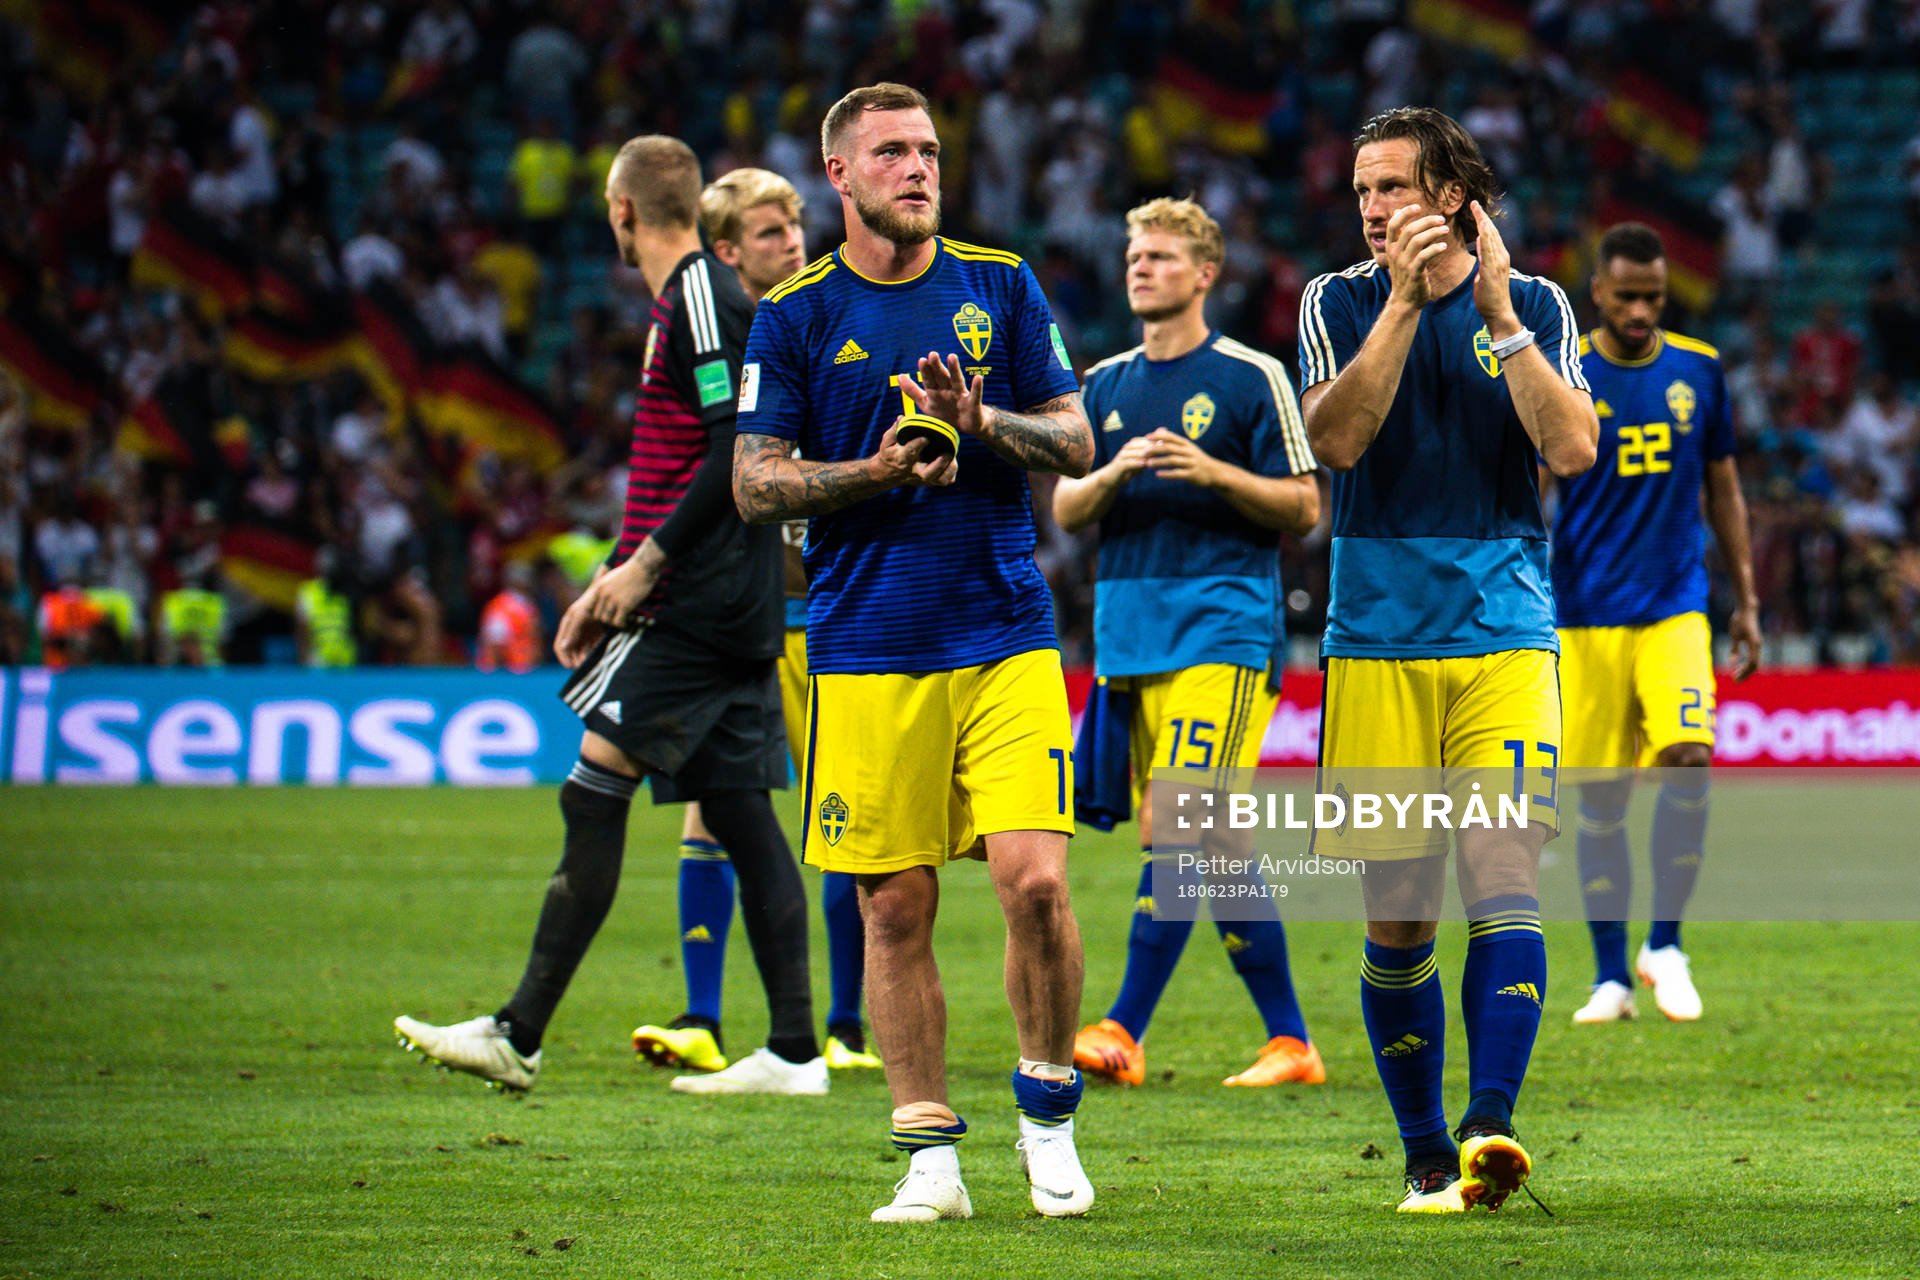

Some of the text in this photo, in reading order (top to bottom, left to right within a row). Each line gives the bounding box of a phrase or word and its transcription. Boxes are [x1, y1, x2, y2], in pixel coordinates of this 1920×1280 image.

[834, 351, 869, 365] adidas
[1617, 422, 1672, 477] 22
[0, 667, 540, 785] isense
[1680, 688, 1716, 734] 2
[1716, 700, 1920, 761] Donal
[1170, 718, 1216, 771] 15
[1048, 748, 1074, 815] 1
[1504, 740, 1557, 809] 13
